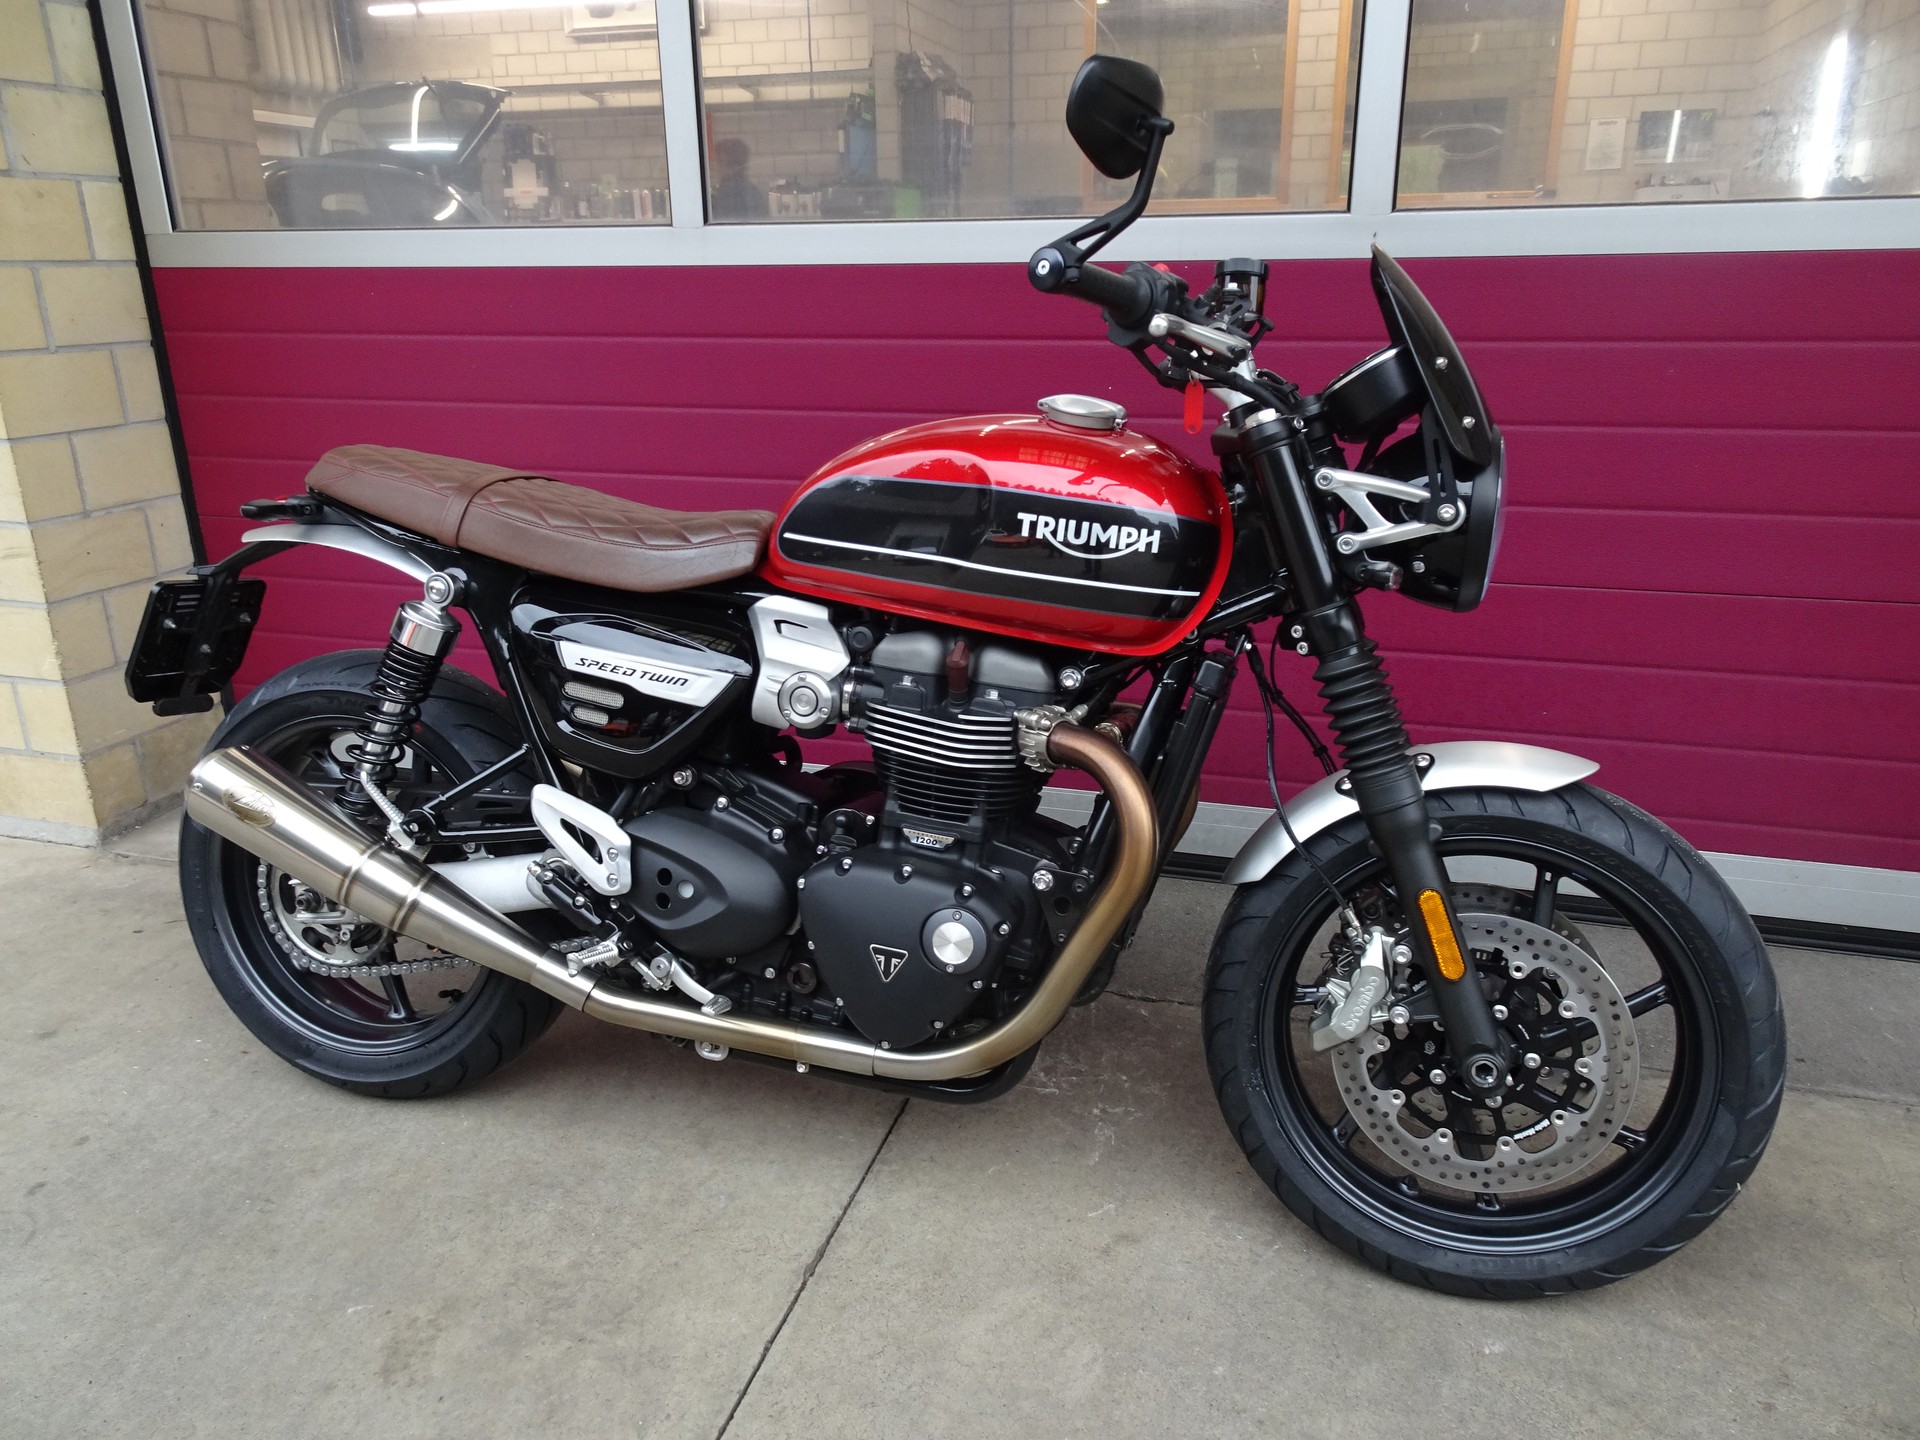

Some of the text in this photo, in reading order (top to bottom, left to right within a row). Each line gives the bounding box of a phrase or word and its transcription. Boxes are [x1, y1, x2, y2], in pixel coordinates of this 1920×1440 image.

[1017, 512, 1161, 559] TRIUMPH
[575, 658, 689, 686] SPEED TWIN
[915, 836, 938, 846] 1200
[1341, 976, 1381, 1032] brembo
